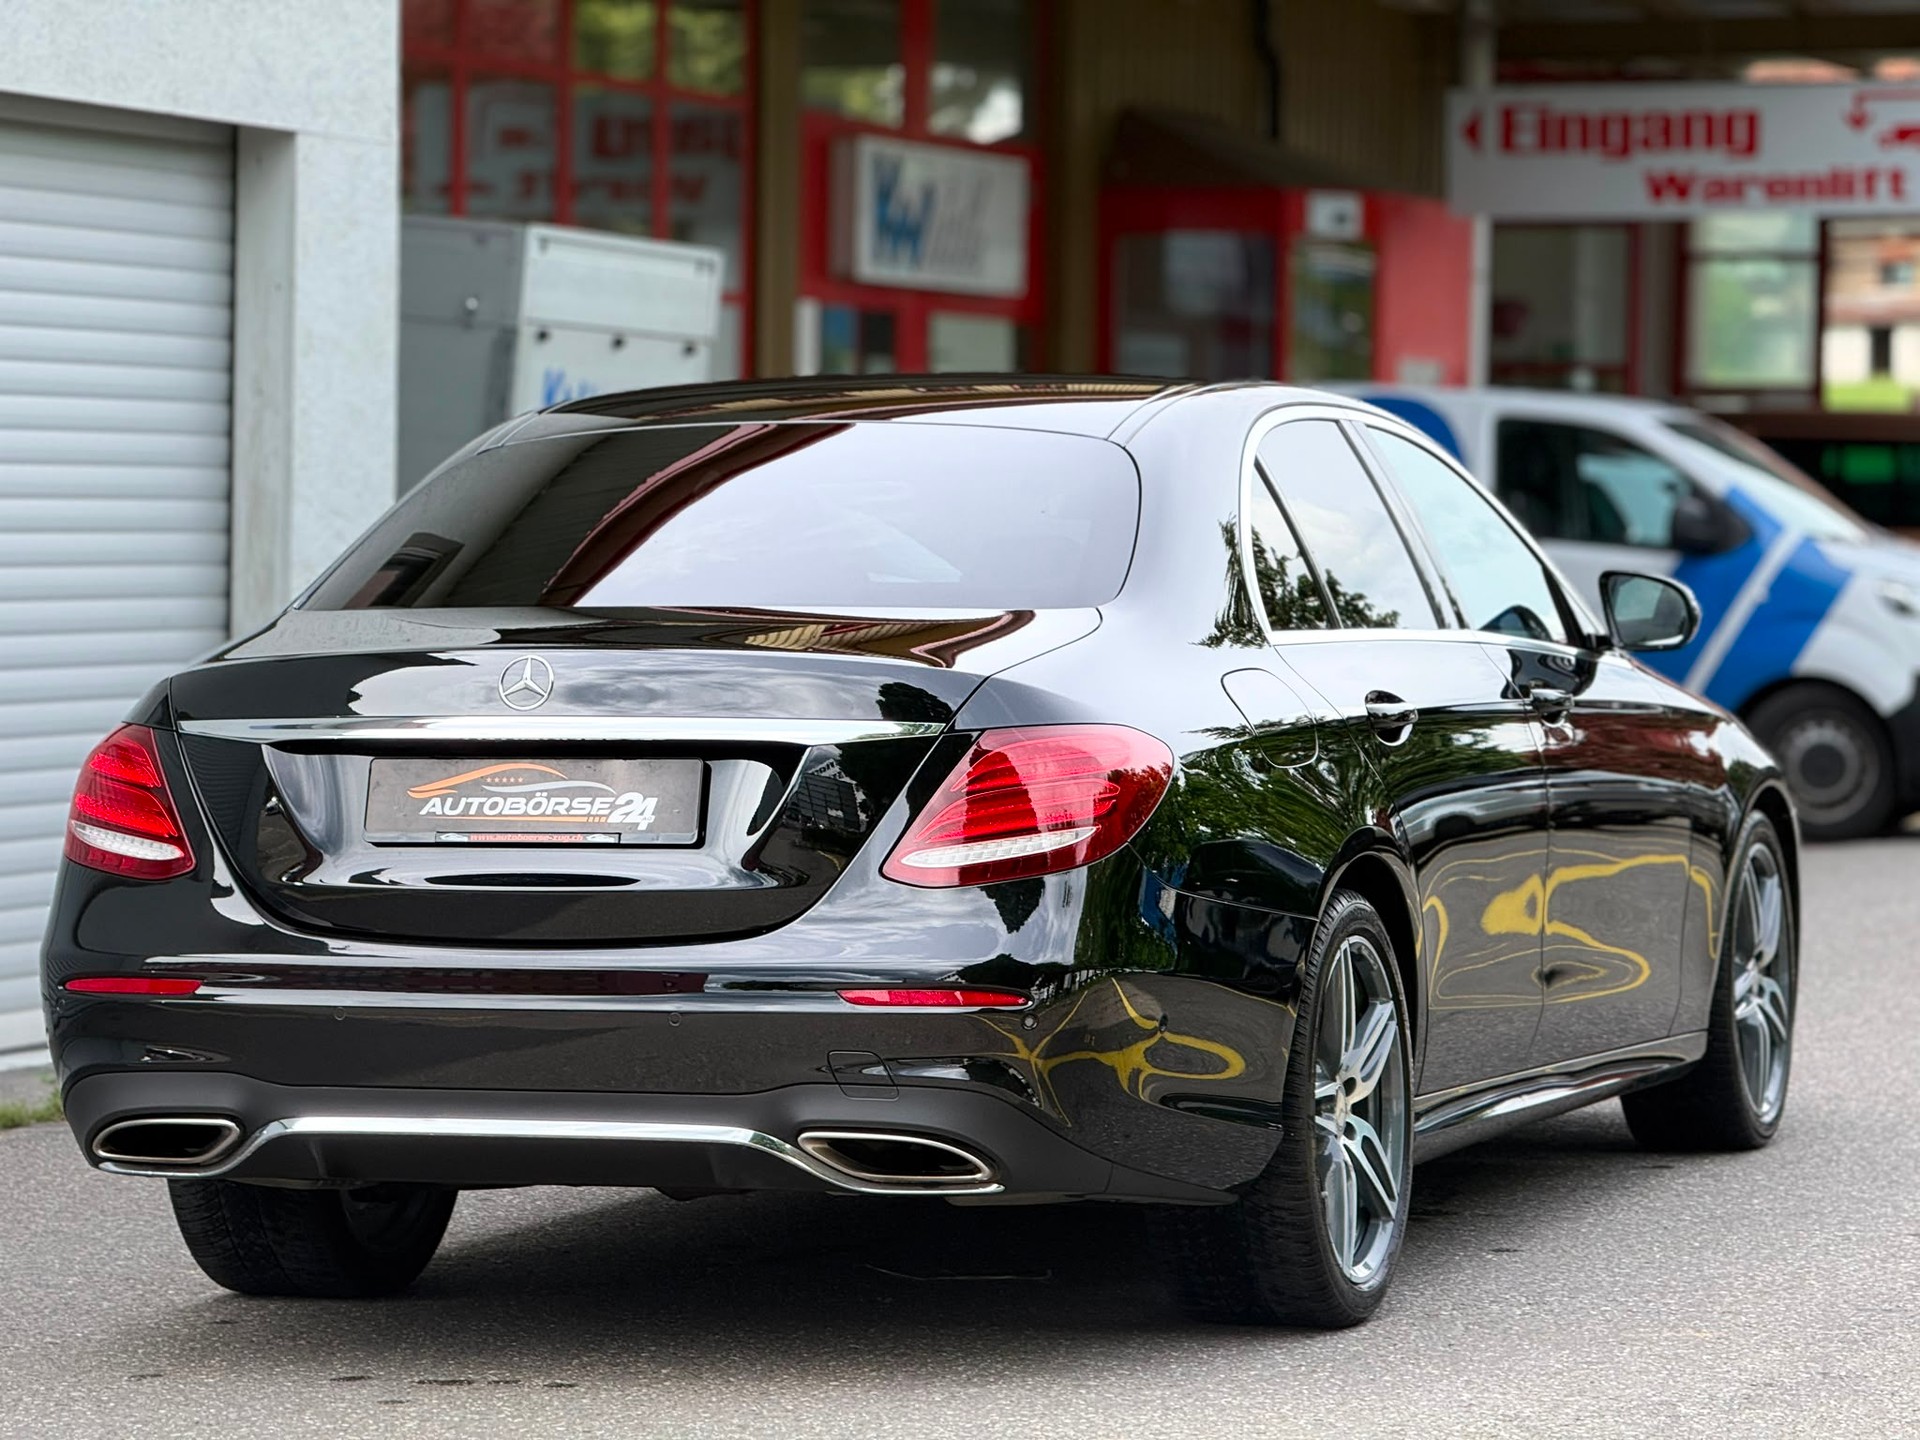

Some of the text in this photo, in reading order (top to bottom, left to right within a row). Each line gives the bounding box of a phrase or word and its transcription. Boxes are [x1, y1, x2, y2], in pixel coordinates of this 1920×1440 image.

[1501, 105, 1759, 159] Eingang
[1645, 166, 1906, 204] Warenlift
[419, 792, 658, 830] AUTOBÖRSE24
